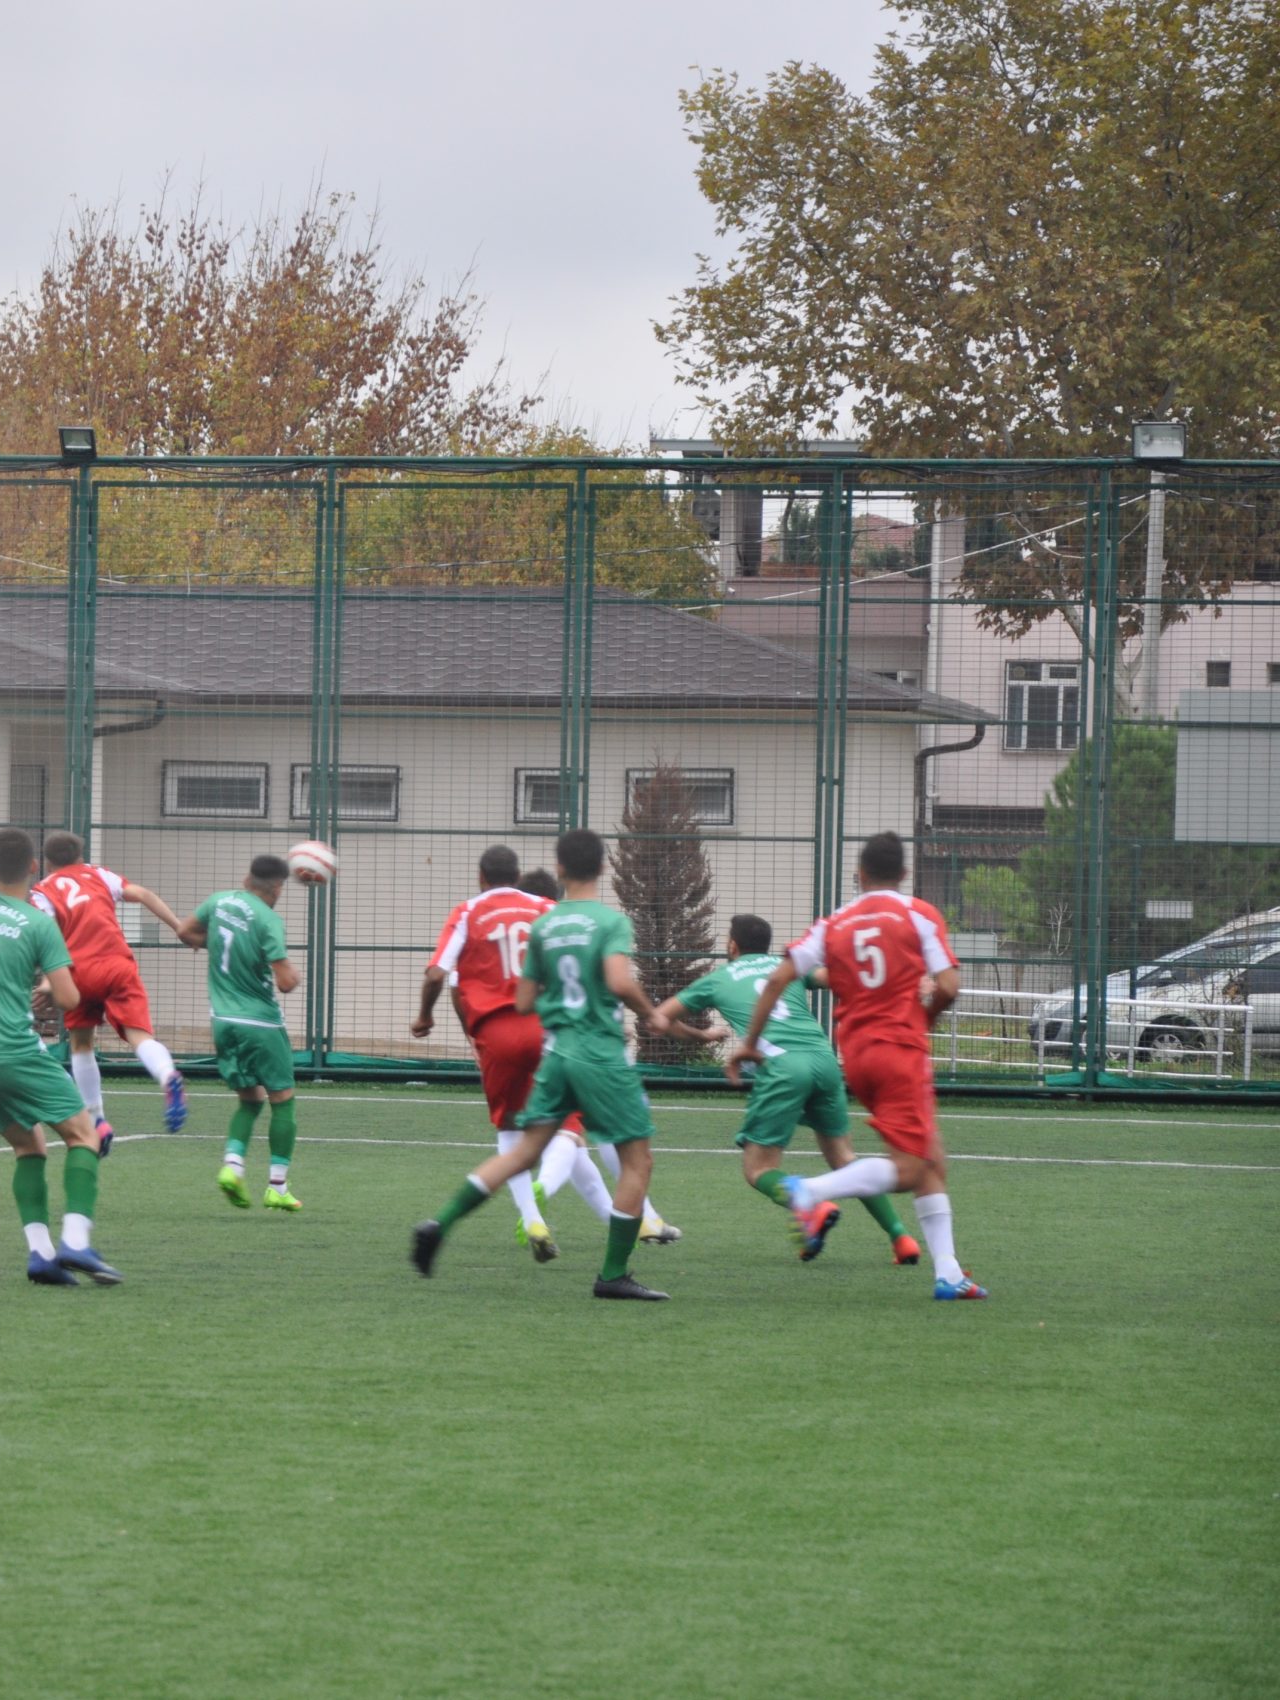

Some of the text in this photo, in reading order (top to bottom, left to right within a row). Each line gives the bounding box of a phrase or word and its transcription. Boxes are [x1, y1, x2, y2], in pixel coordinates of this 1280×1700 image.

[56, 876, 91, 909] 2
[218, 925, 234, 974] 7
[854, 926, 887, 988] 5
[558, 954, 587, 1009] 8
